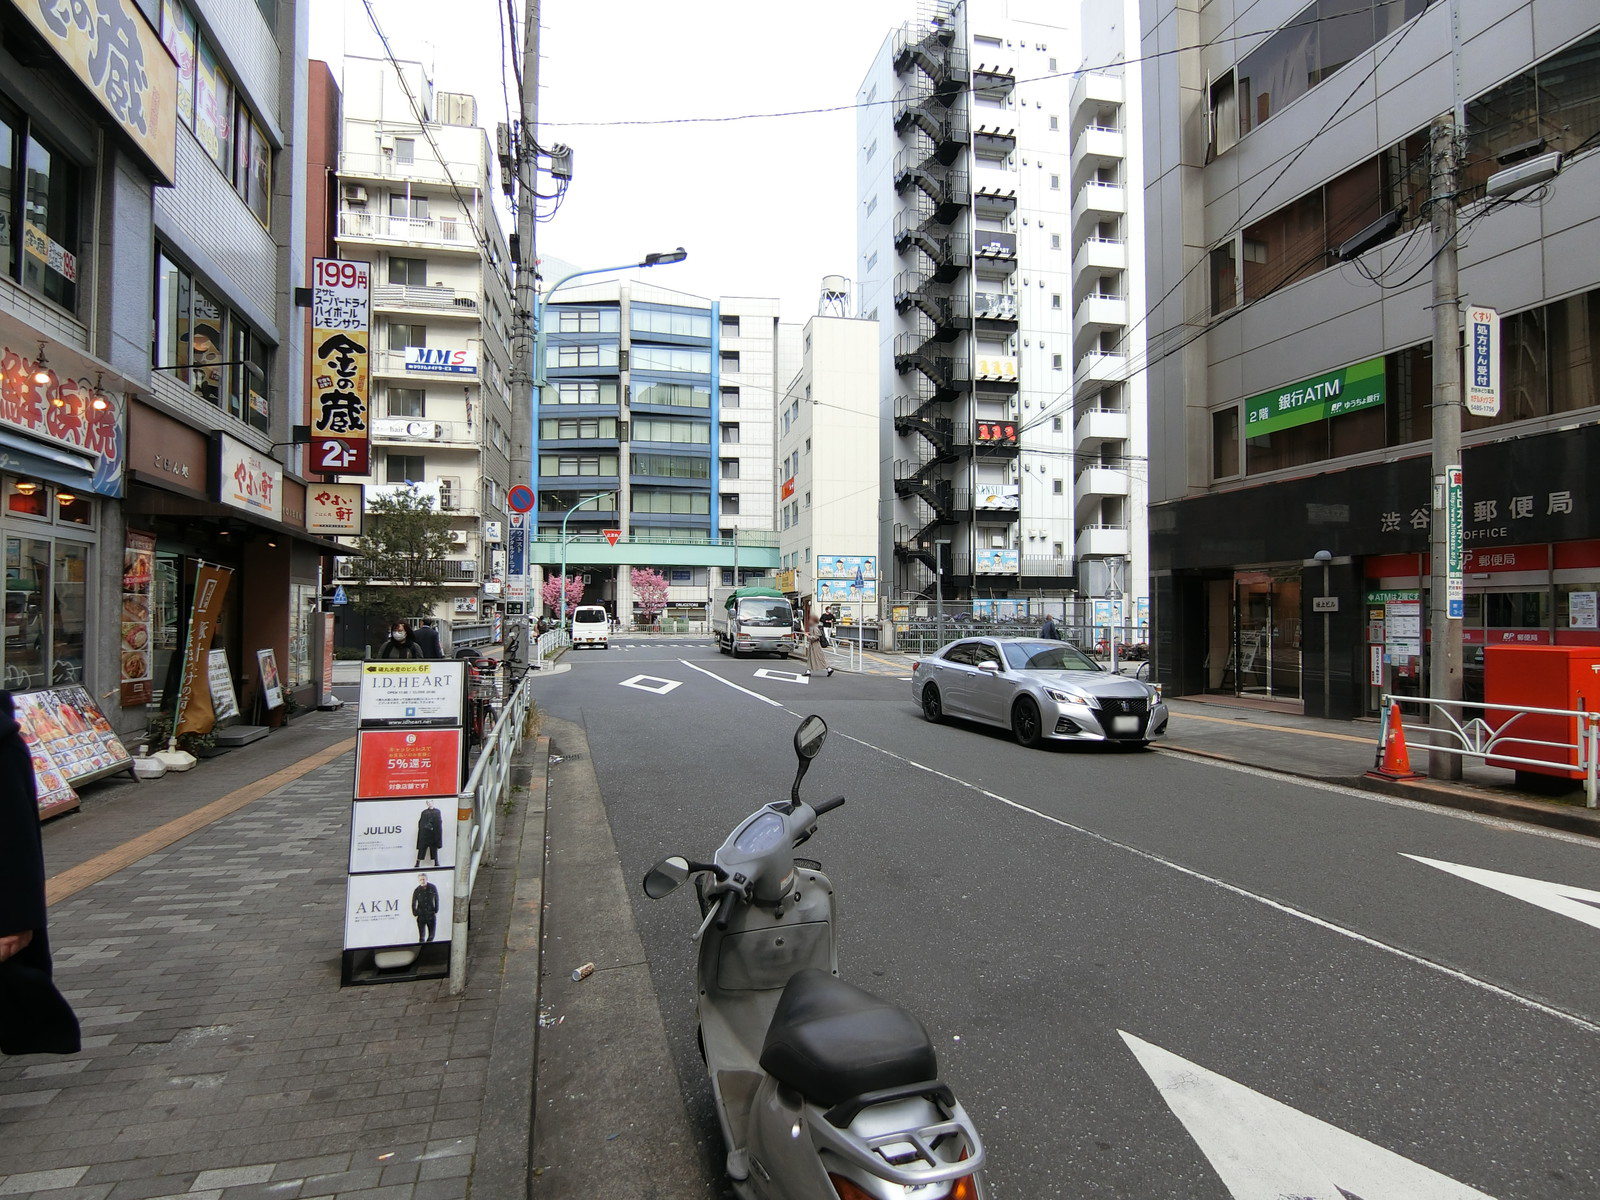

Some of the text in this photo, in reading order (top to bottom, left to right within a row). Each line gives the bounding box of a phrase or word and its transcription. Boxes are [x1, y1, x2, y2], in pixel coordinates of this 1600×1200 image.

[316, 262, 367, 289] 199円
[315, 288, 335, 296] アサヒ
[315, 296, 368, 308] スーパードライ
[315, 306, 358, 318] ハイボール
[1473, 311, 1492, 322] くすり
[315, 317, 367, 329] レモンサワー
[415, 348, 467, 365] MMS
[1477, 324, 1488, 386] 処方せん受付
[316, 333, 367, 433] 金の蔵
[1249, 379, 1340, 423] 2階 銀行ATM
[1344, 393, 1381, 409] ゆうちょ銀行
[322, 440, 358, 468] 2F
[153, 455, 190, 479] ごはん処
[234, 459, 274, 505] やよい軒
[315, 490, 353, 506] やよい
[335, 507, 353, 522] 軒
[1381, 490, 1574, 532] 渋谷 郵便局
[1463, 526, 1509, 541] OFFICE
[1478, 554, 1517, 567] 郵便局
[418, 664, 429, 672] 6F
[372, 675, 453, 688] I.D.HEART
[388, 758, 431, 769] 5%還元
[363, 825, 402, 835] JULIUS
[356, 899, 399, 914] AKM
